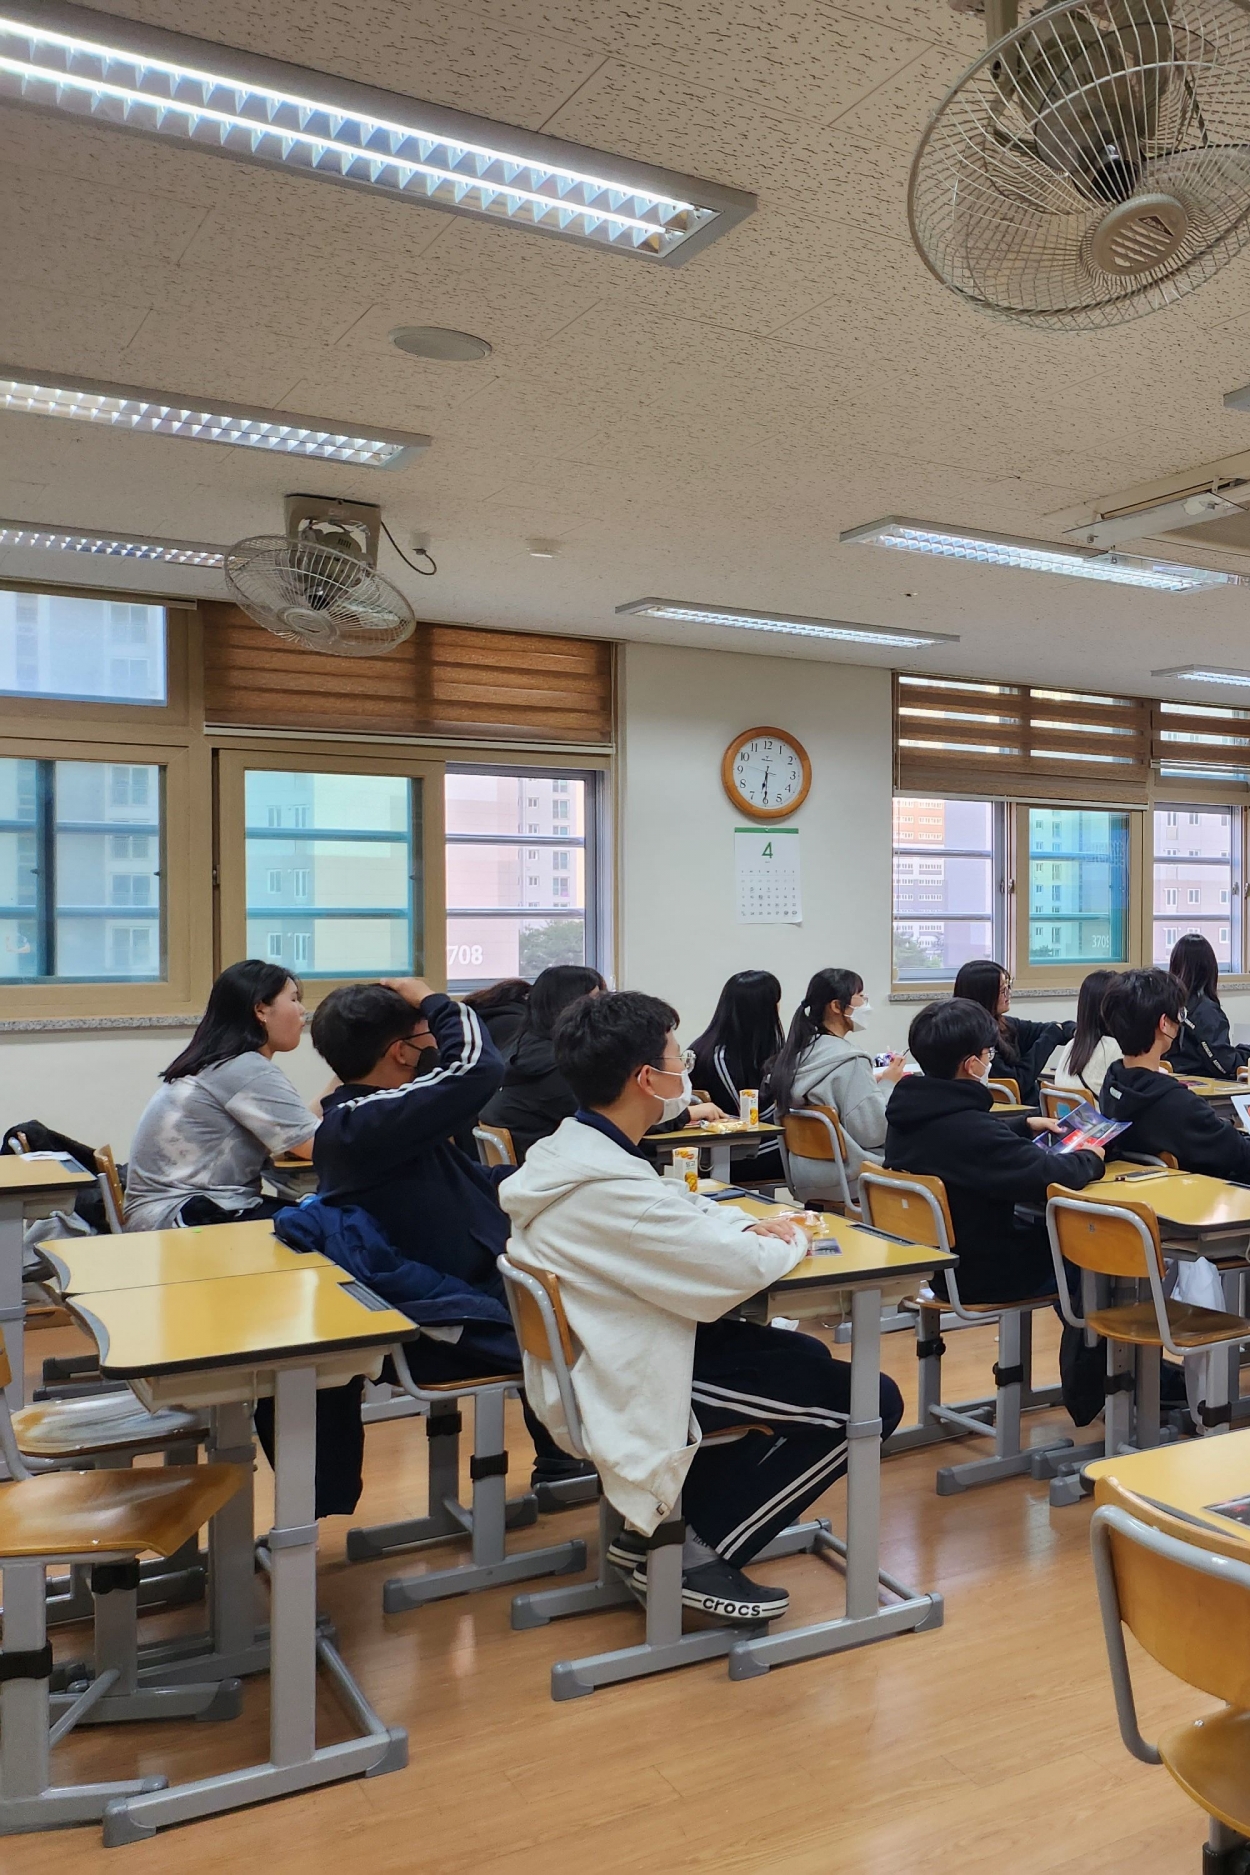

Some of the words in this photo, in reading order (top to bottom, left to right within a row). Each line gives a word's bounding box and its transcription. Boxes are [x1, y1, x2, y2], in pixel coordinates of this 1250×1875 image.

[750, 742, 758, 752] 11
[764, 740, 773, 750] 12
[740, 752, 750, 761] 10
[787, 755, 793, 765] 2
[737, 765, 744, 774] 9
[789, 770, 796, 780] 3
[739, 779, 746, 788] 8
[784, 783, 791, 793] 4
[749, 791, 755, 800] 7
[775, 793, 783, 803] 5
[761, 841, 774, 859] 4
[447, 944, 483, 966] 708
[702, 1598, 761, 1616] crocs
